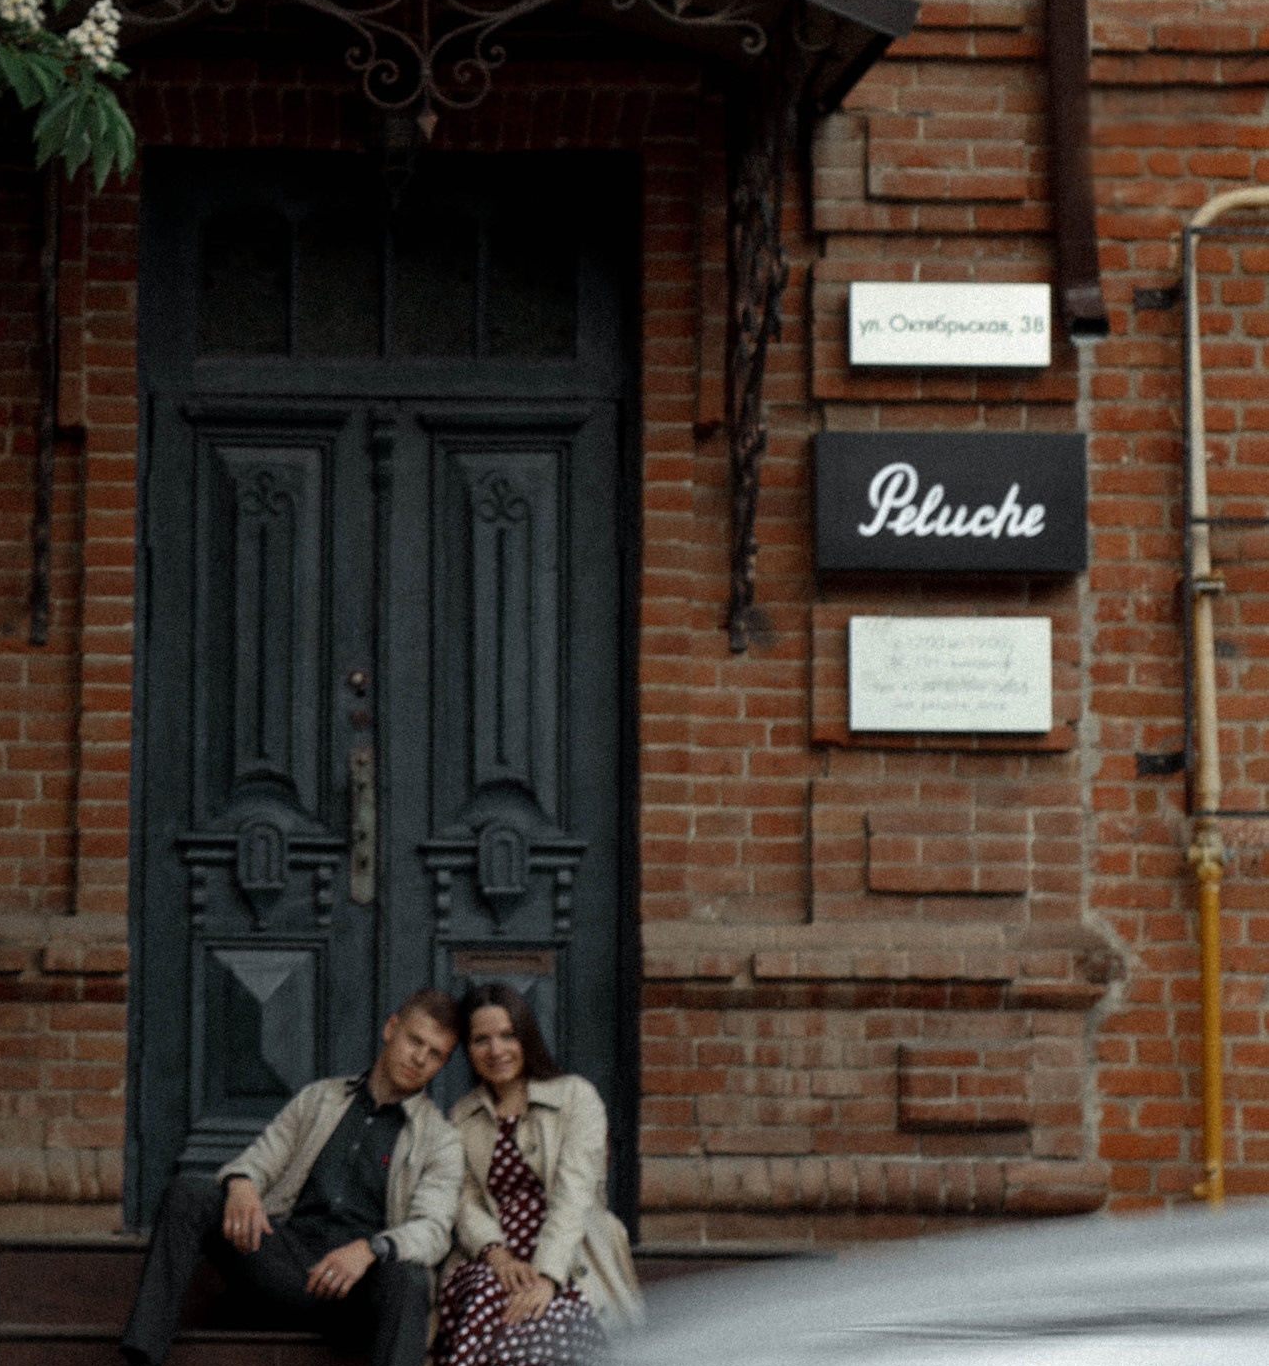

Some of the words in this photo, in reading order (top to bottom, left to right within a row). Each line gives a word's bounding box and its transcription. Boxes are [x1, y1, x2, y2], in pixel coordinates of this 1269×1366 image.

[859, 319, 882, 336] ул.
[889, 313, 1012, 338] Октябрьская,
[858, 463, 1046, 538] Peluche
